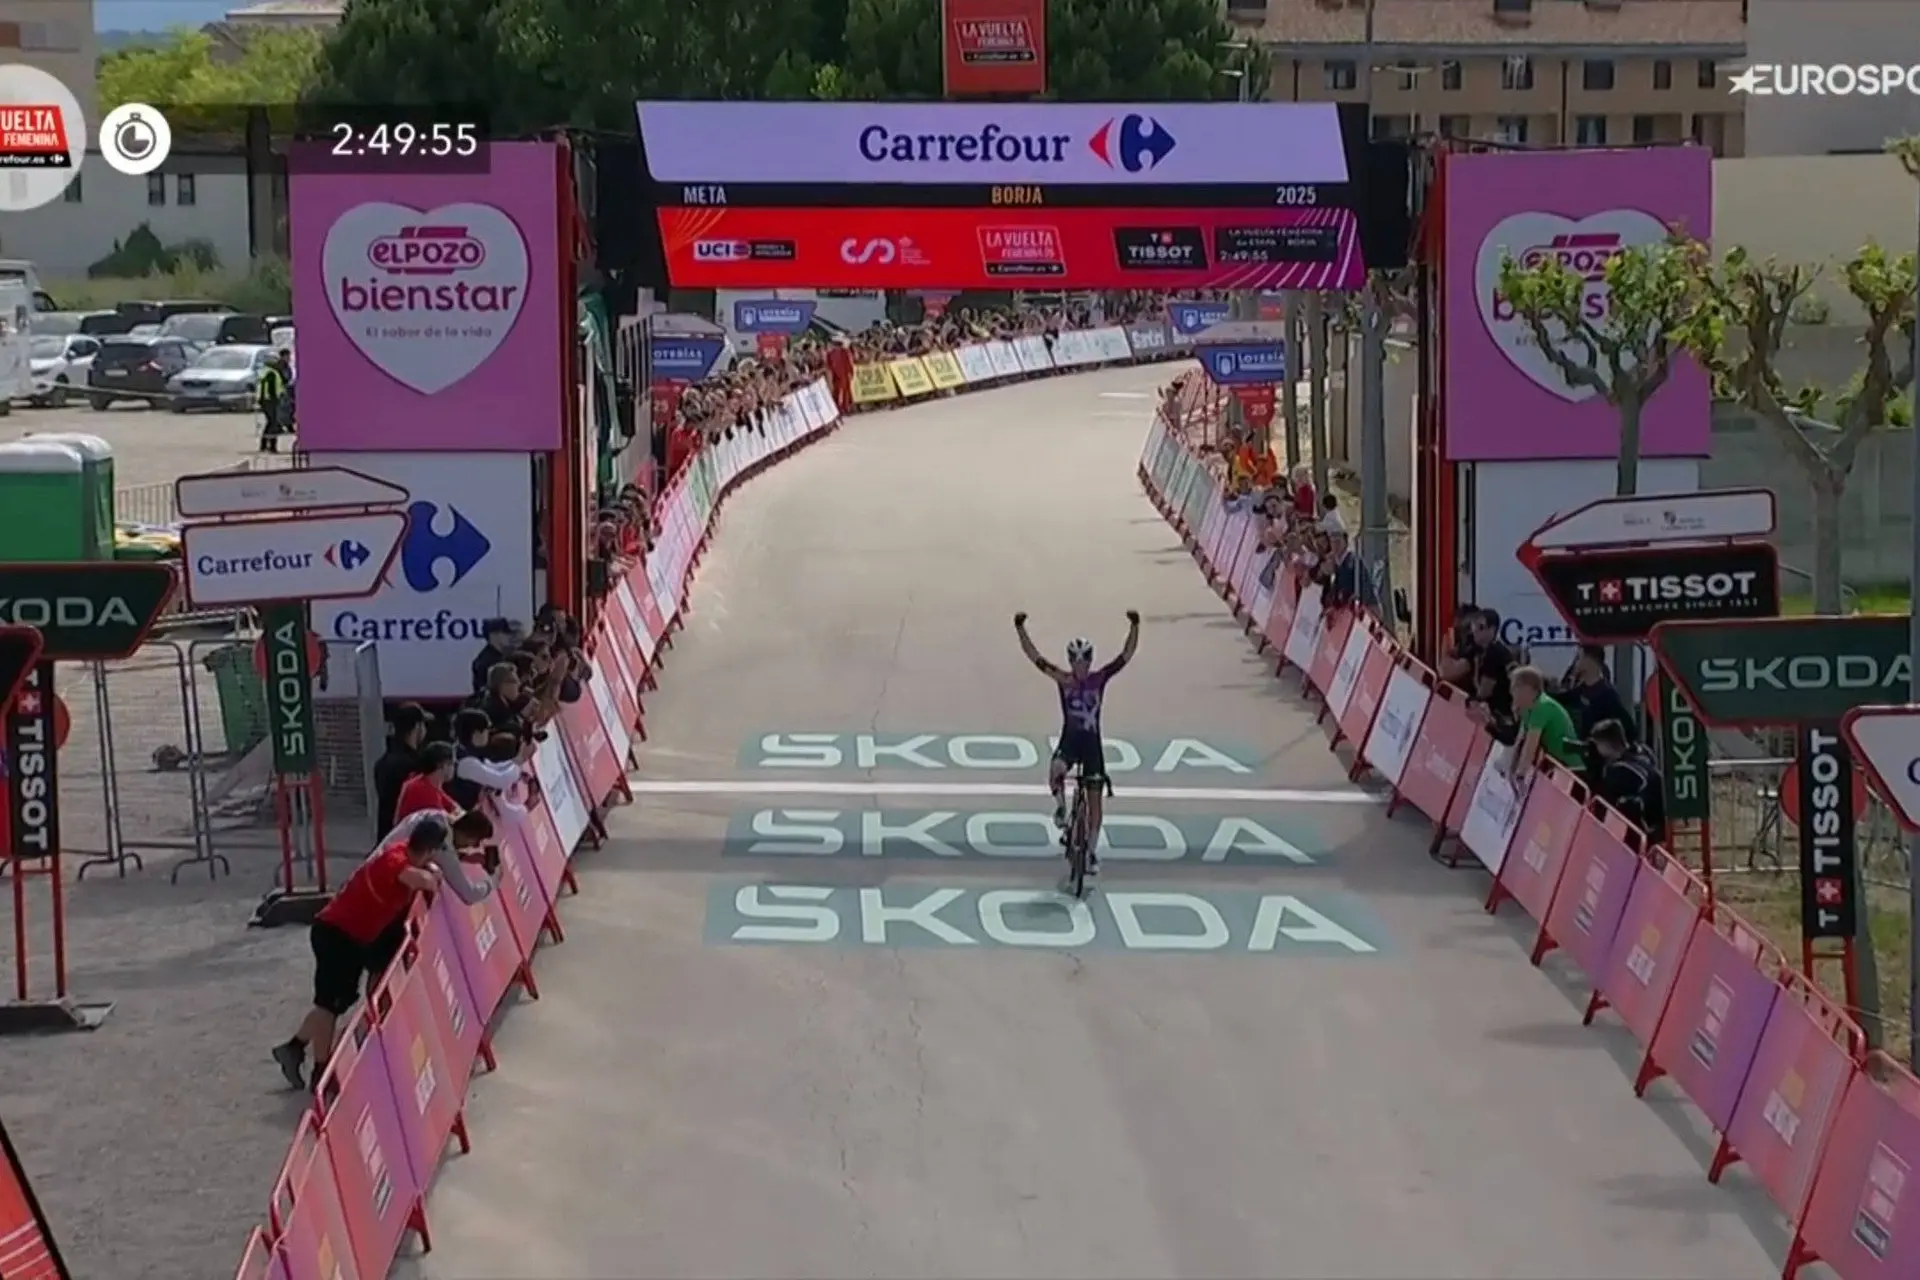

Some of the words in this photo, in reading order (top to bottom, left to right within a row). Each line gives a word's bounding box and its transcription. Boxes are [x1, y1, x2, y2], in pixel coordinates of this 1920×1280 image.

[859, 123, 1071, 162] Carrefour
[683, 186, 727, 204] META
[991, 186, 1043, 204] BORJA
[1276, 186, 1317, 205] 2025
[986, 231, 1001, 247] LA
[1003, 231, 1053, 246] VUELTA
[698, 244, 730, 257] UCI
[1128, 245, 1194, 258] TISSOT
[341, 276, 517, 311] bienstar
[424, 325, 441, 337] de
[653, 348, 703, 359] OTERÍAS
[1238, 353, 1284, 363] LOTERÍA
[198, 550, 313, 575] Carrefour
[1625, 572, 1756, 600] TISSOT
[0, 596, 137, 627] ODA
[334, 610, 487, 640] Carrefou
[1671, 687, 1698, 799] SKOD
[17, 719, 48, 850] TISSOT
[1811, 728, 1841, 873] TISSOT
